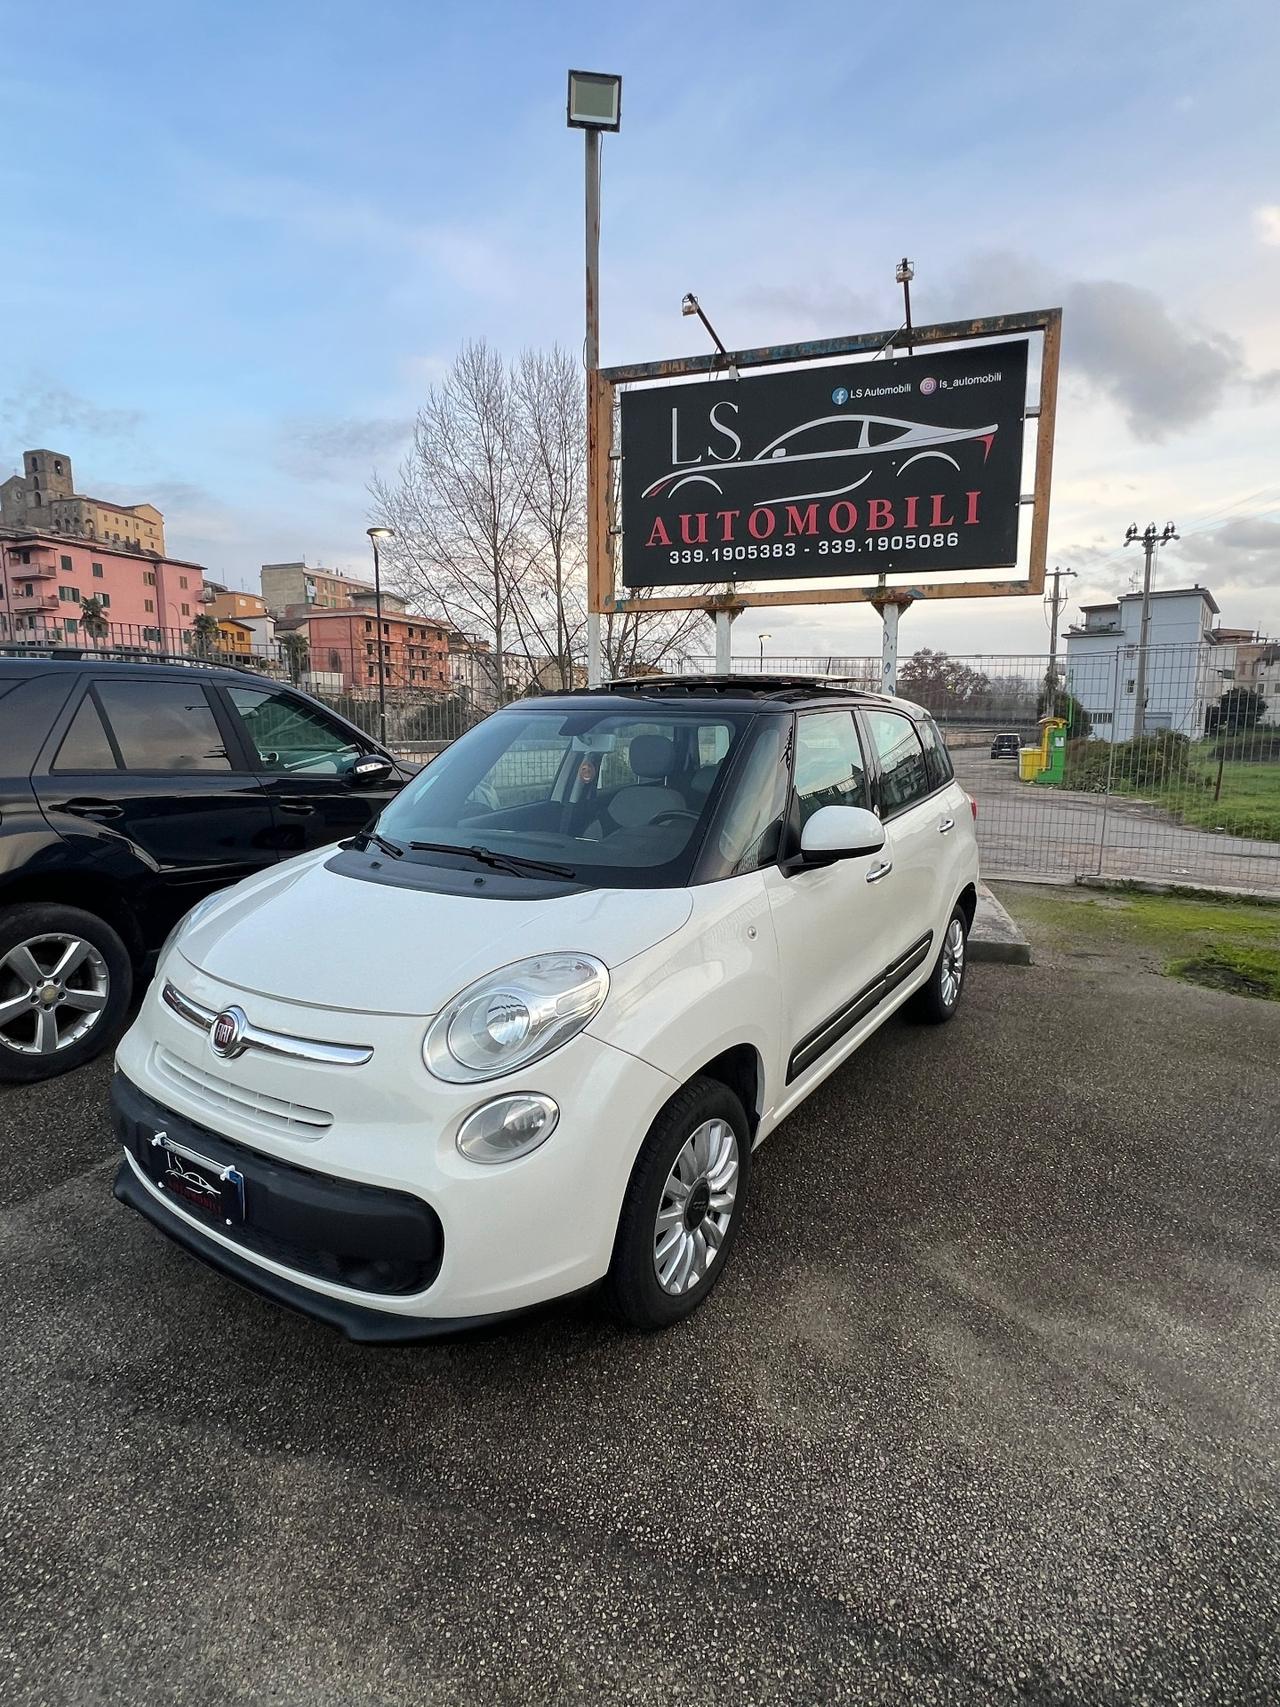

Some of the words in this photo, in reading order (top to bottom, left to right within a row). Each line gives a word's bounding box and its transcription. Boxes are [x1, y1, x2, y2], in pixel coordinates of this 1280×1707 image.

[850, 388, 863, 399] LS
[864, 383, 912, 397] Automobili
[939, 372, 1002, 390] ls_automobili
[672, 401, 741, 464] LS
[644, 491, 982, 547] AUTOMOBILI
[669, 543, 796, 564] 339.1905383
[818, 533, 959, 555] 339.1905086
[215, 1022, 234, 1043] FIAT
